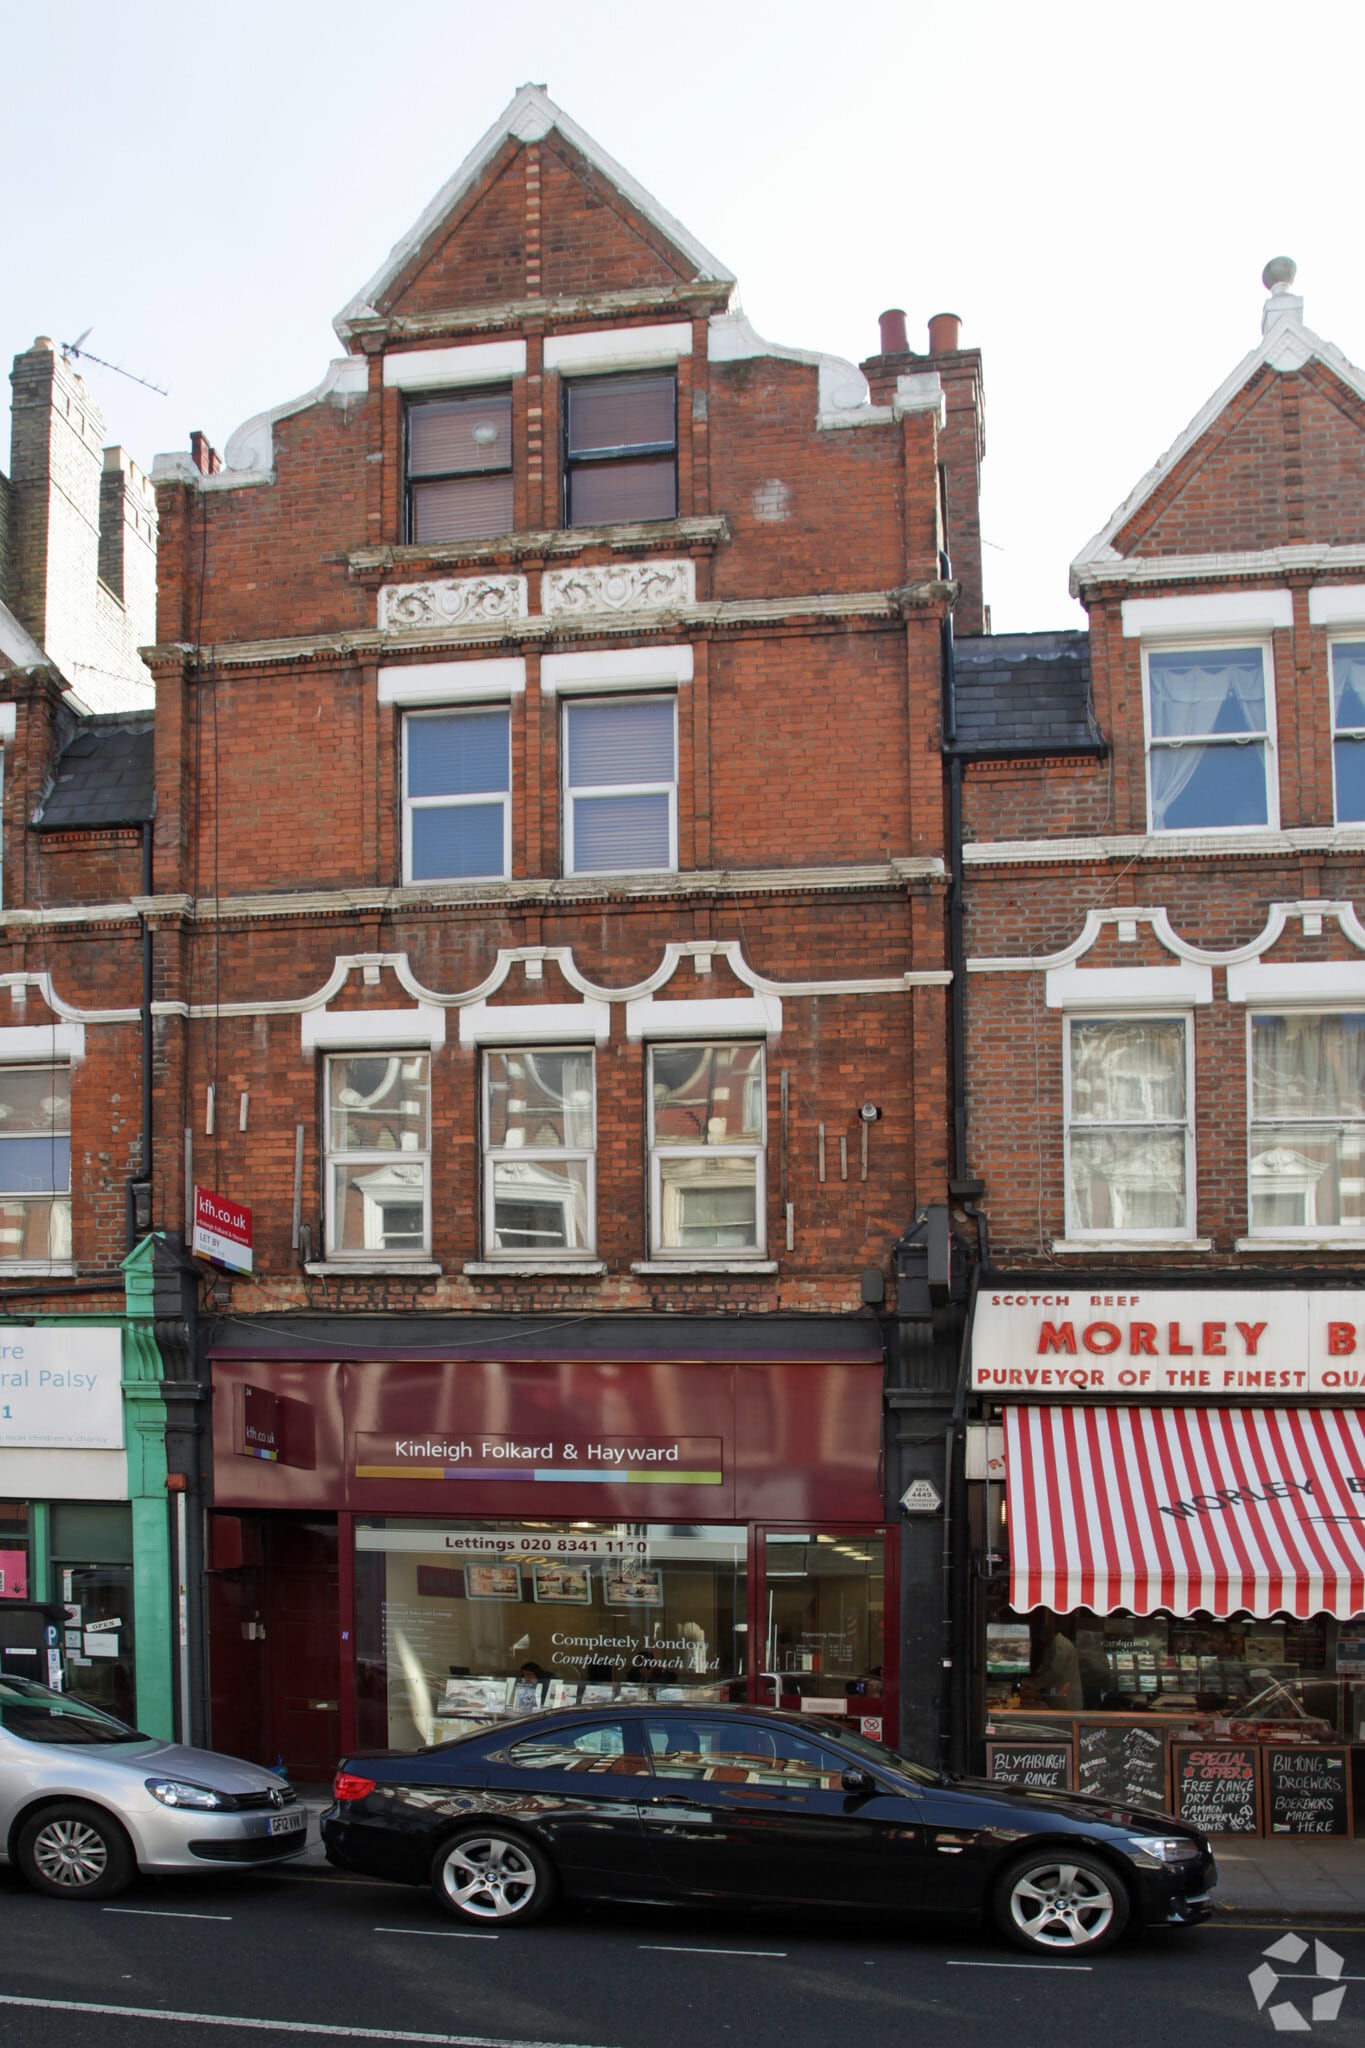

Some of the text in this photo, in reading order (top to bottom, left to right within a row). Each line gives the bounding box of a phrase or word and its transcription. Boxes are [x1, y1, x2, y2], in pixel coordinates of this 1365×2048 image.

[199, 1196, 246, 1230] kfh.co.uk
[199, 1232, 221, 1248] LET BY
[992, 1295, 1140, 1306] SCOTCH BEEF
[1037, 1321, 1365, 1356] MORLEY B
[0, 1344, 24, 1360] re
[39, 1369, 97, 1391] Palsy
[977, 1368, 1105, 1386] PURVEYOR
[1118, 1369, 1152, 1386] OF
[1166, 1370, 1211, 1386] THE
[1223, 1370, 1306, 1387] FINEST
[2, 1405, 13, 1419] 1
[246, 1426, 275, 1444] kfh.co.uk
[395, 1441, 679, 1464] Kinleigh Folkard & Hayward
[1158, 1479, 1313, 1521] MORLEY
[445, 1537, 648, 1553] Lettings 020 8341 1110
[91, 1620, 115, 1630] OPEN
[551, 1632, 709, 1652] Completely London
[551, 1651, 627, 1670] Completely
[631, 1654, 684, 1669] Crouch
[993, 1753, 1066, 1769] BLYTHBURGH
[1187, 1751, 1251, 1767] SPECIAL
[1023, 1771, 1059, 1787] RANGE
[1200, 1766, 1242, 1779] OFFER
[1180, 1779, 1255, 1794] FREE RANGE
[1185, 1793, 1250, 1804] DRY CURED
[1275, 1796, 1334, 1811] BOEREWORS
[1181, 1804, 1224, 1818] GAMMON
[1190, 1813, 1228, 1823] SLIPPER
[1285, 1810, 1317, 1822] MADE
[1296, 1819, 1335, 1833] HERE
